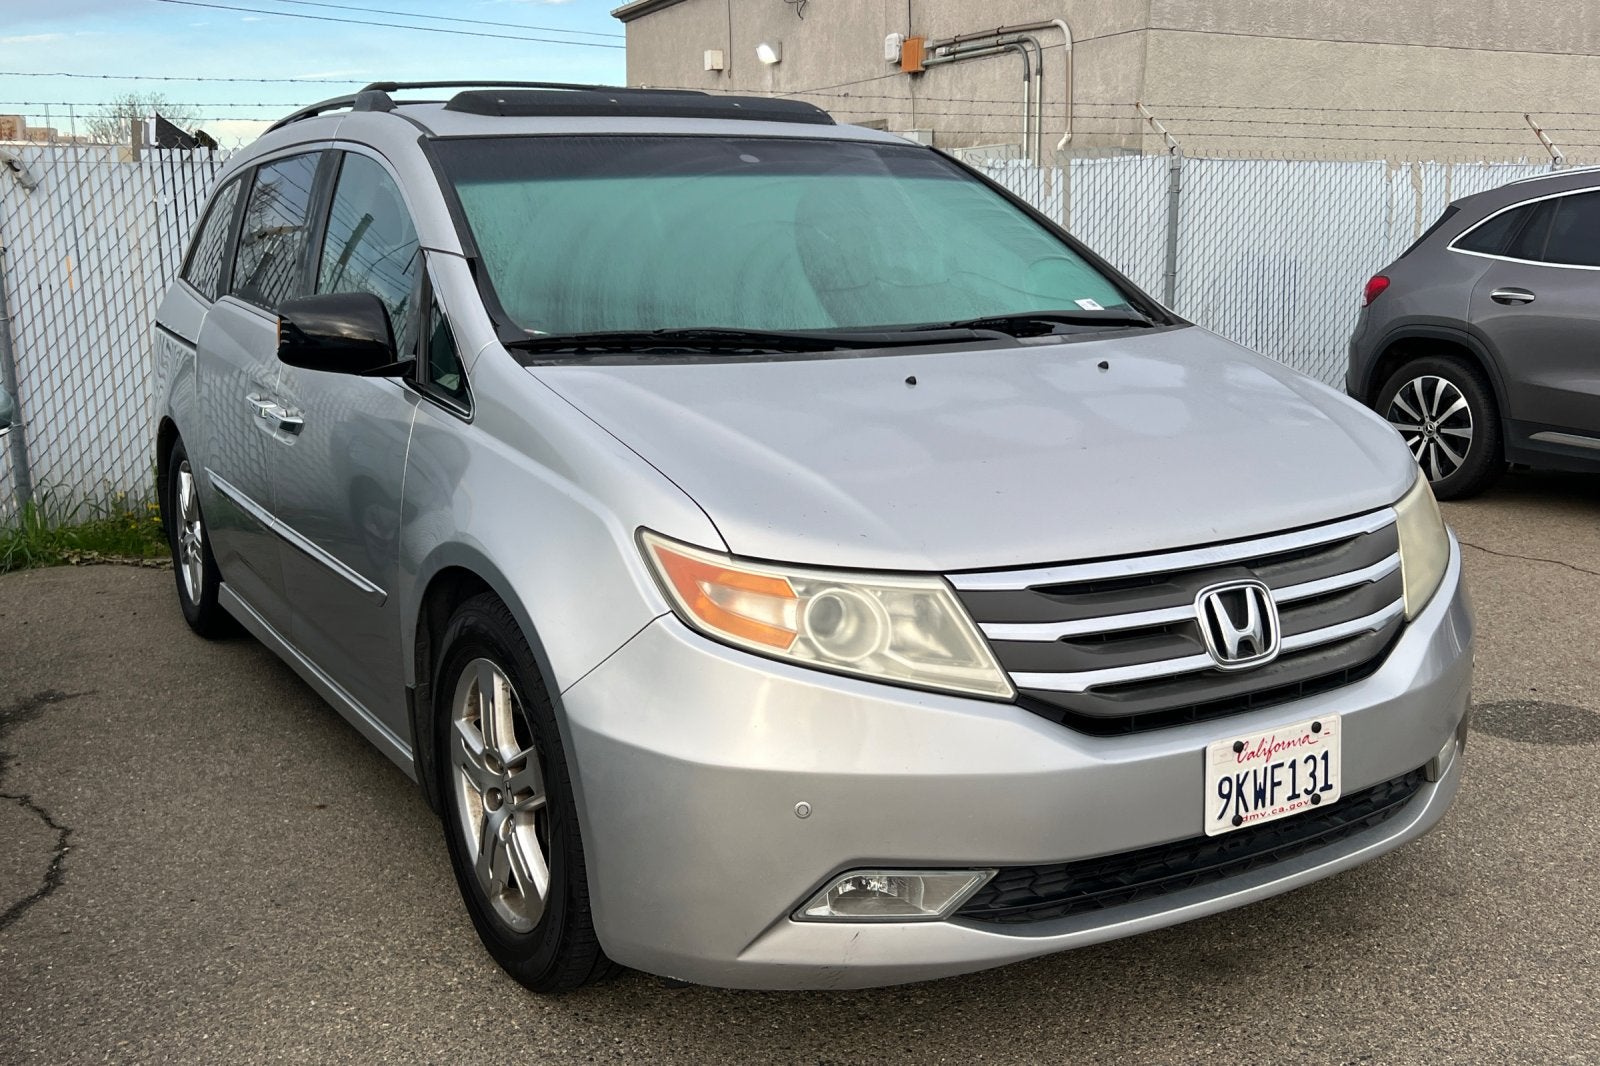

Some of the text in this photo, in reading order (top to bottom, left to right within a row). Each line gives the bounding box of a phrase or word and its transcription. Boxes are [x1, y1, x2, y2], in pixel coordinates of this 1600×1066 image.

[1236, 733, 1318, 764] California
[1217, 750, 1333, 820] 9KWF131
[1241, 799, 1311, 823] dmv.ca.gov
